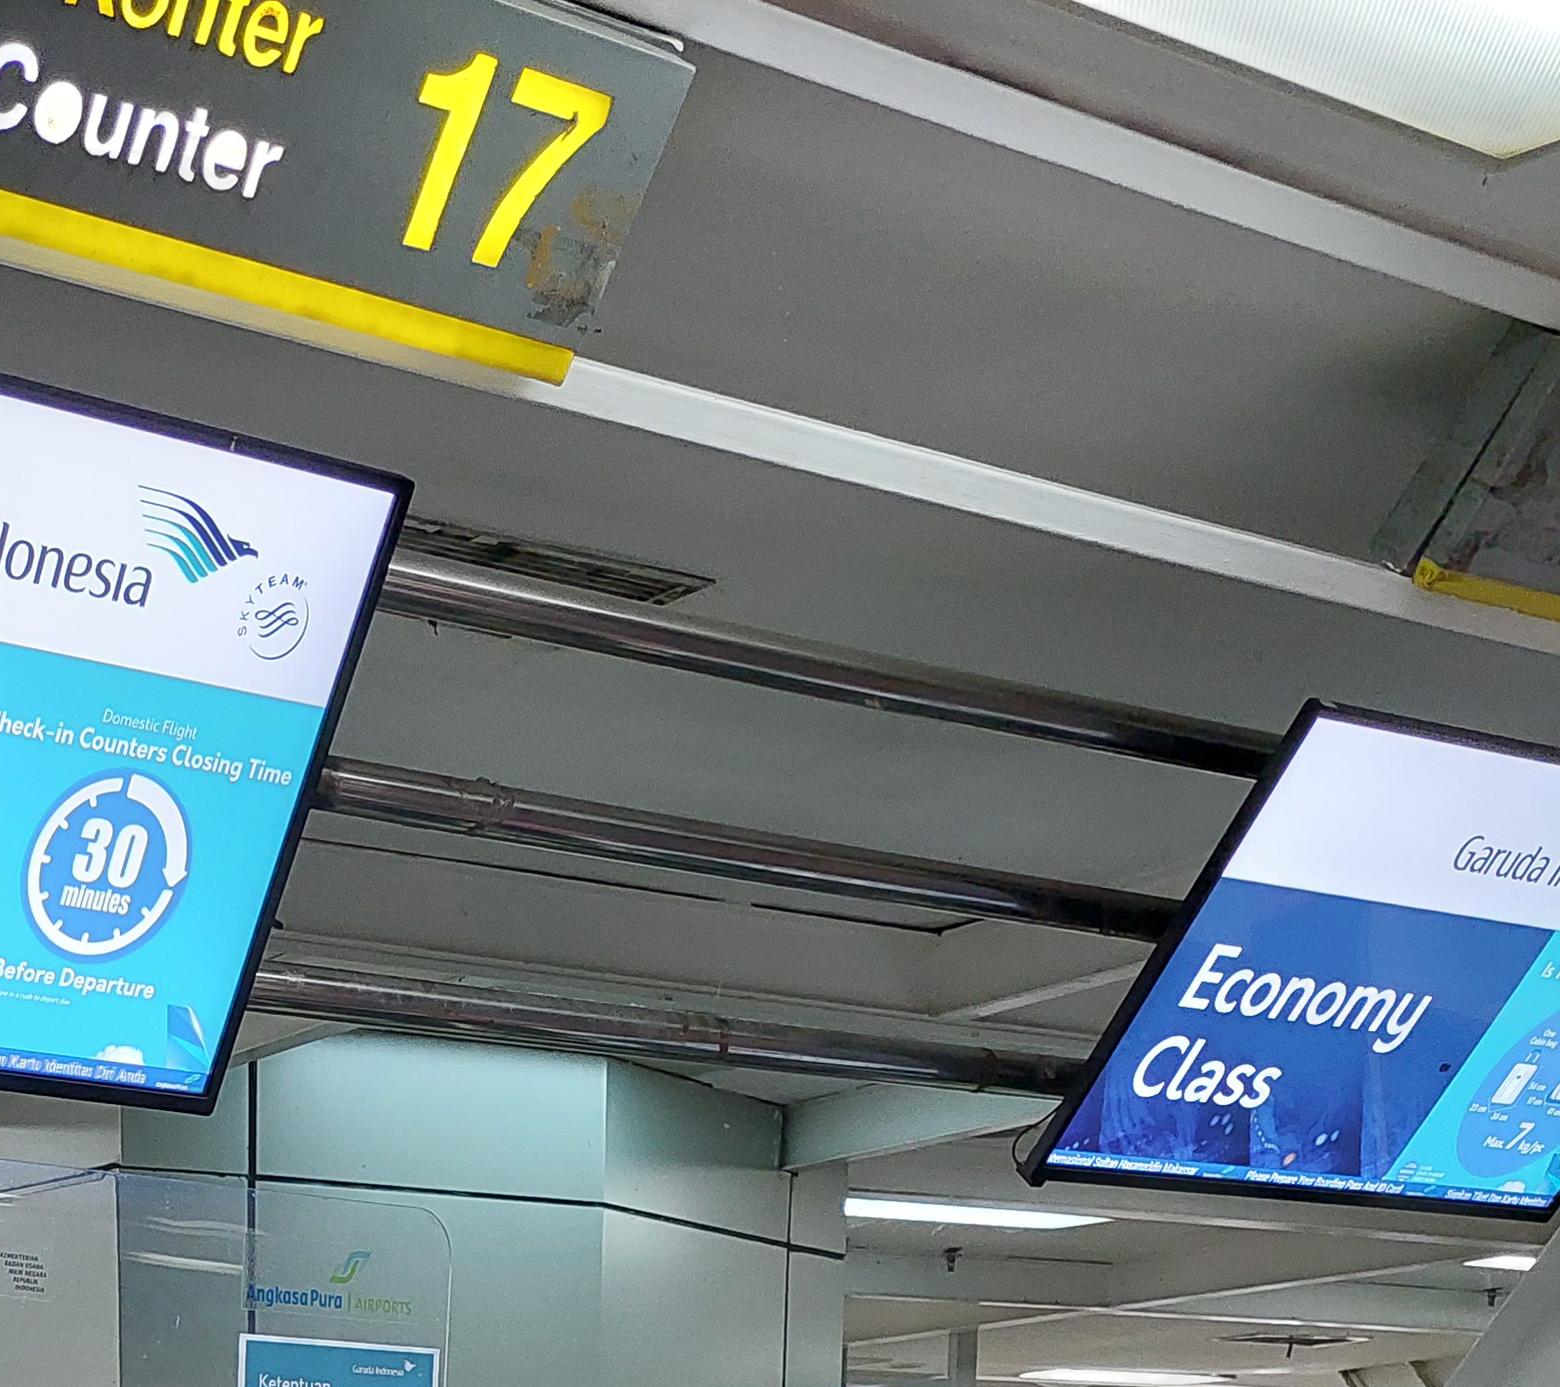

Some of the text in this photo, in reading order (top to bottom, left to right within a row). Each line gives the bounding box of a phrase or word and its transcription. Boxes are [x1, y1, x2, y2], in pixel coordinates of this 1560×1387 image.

[402, 53, 613, 268] 17
[237, 573, 305, 637] SKYTEAM
[102, 708, 198, 742] Domestic Flight
[78, 727, 168, 764] Counters
[171, 744, 243, 784] Closing
[248, 757, 293, 787] Time
[70, 817, 149, 889] 30
[1453, 835, 1551, 884] Garuda
[59, 883, 132, 916] minutes
[58, 967, 156, 1001] Departure
[1177, 943, 1433, 1054] Economy
[1132, 1034, 1284, 1109] Class
[1504, 1121, 1536, 1150] 7
[354, 1296, 413, 1316] AIRPORTS
